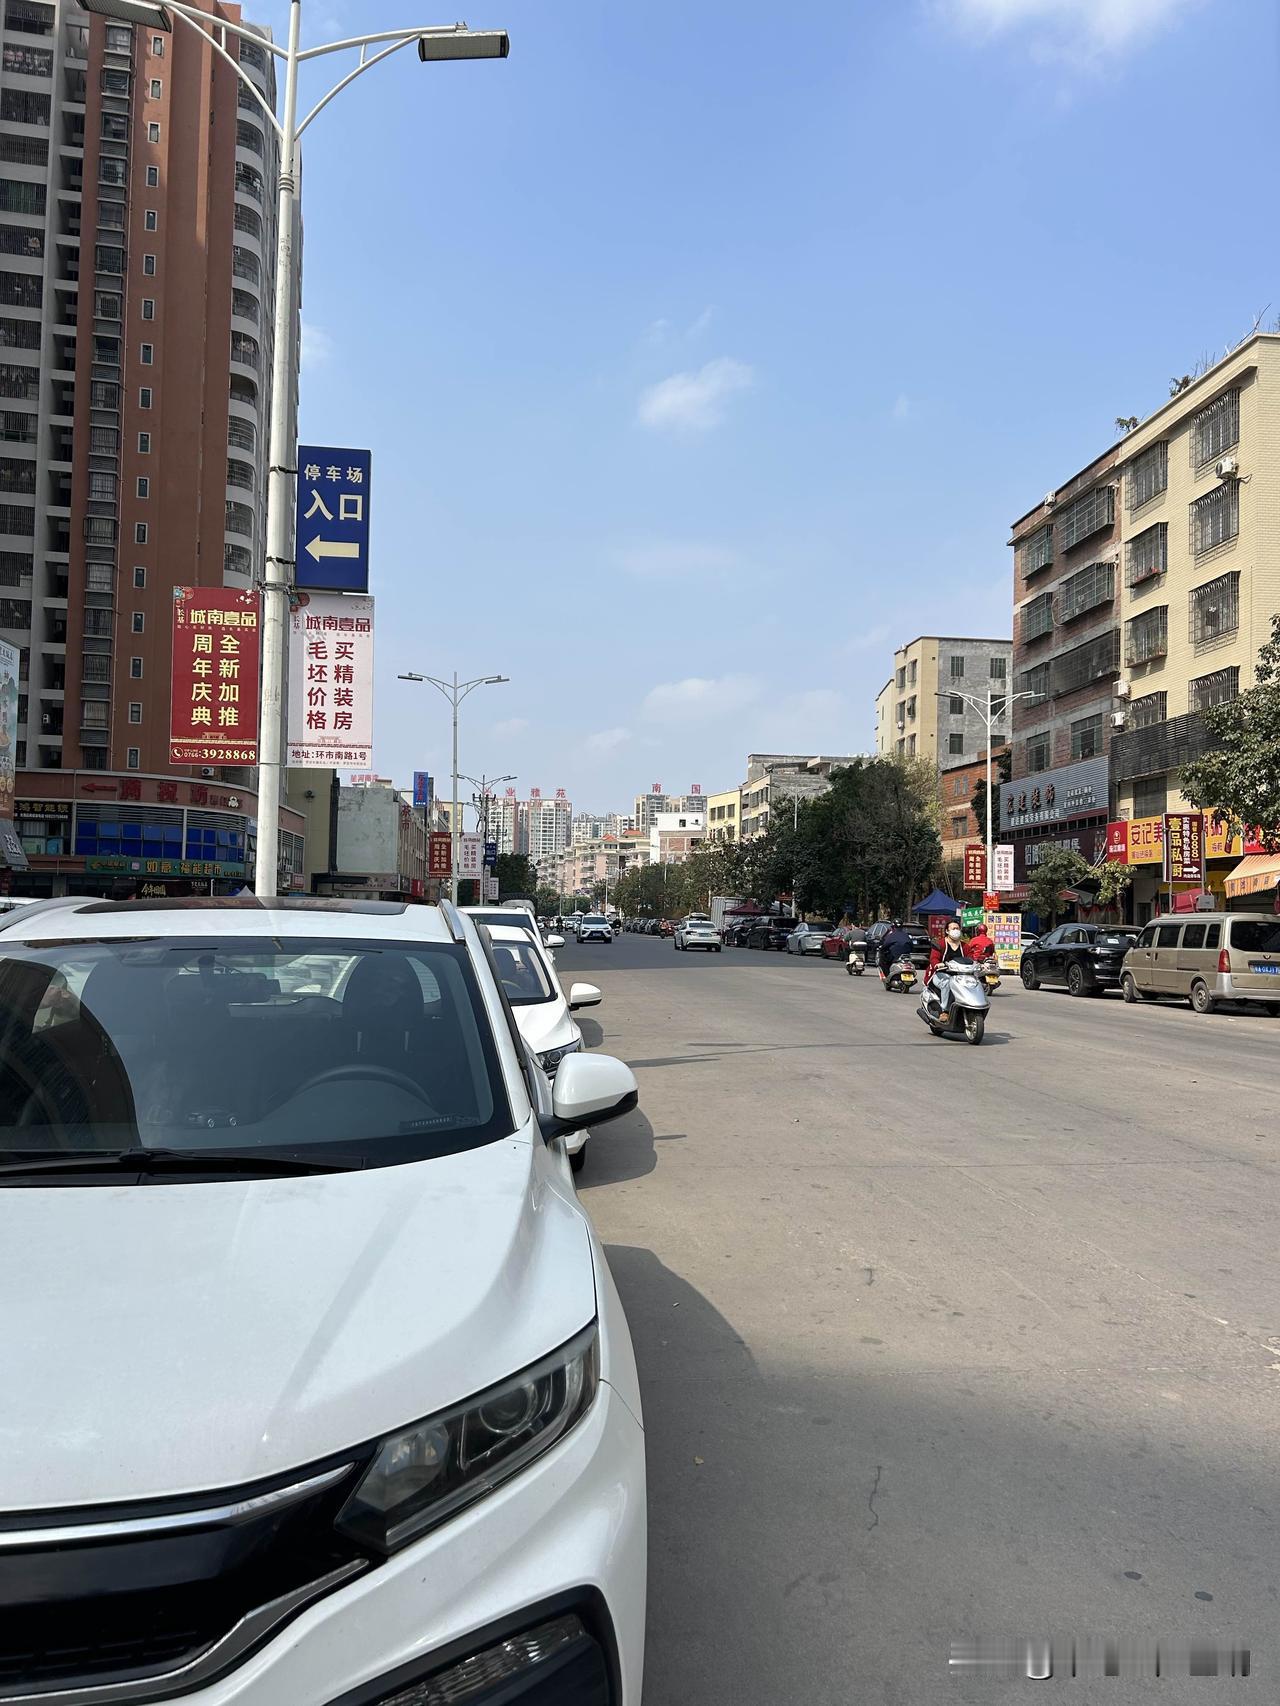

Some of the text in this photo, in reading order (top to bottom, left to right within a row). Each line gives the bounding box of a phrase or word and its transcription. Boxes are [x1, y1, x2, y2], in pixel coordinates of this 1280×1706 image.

[304, 464, 363, 484] 停车场
[304, 488, 363, 521] 入口
[190, 609, 257, 627] 城南壹品
[305, 615, 371, 632] 城南壹品
[191, 634, 213, 727] 周年庆典
[218, 634, 241, 727] 全新加推
[306, 640, 328, 730] 毛坯价格
[333, 641, 354, 730] 买精装房
[652, 783, 701, 795] 南国
[1168, 817, 1183, 878] 壹品私厨
